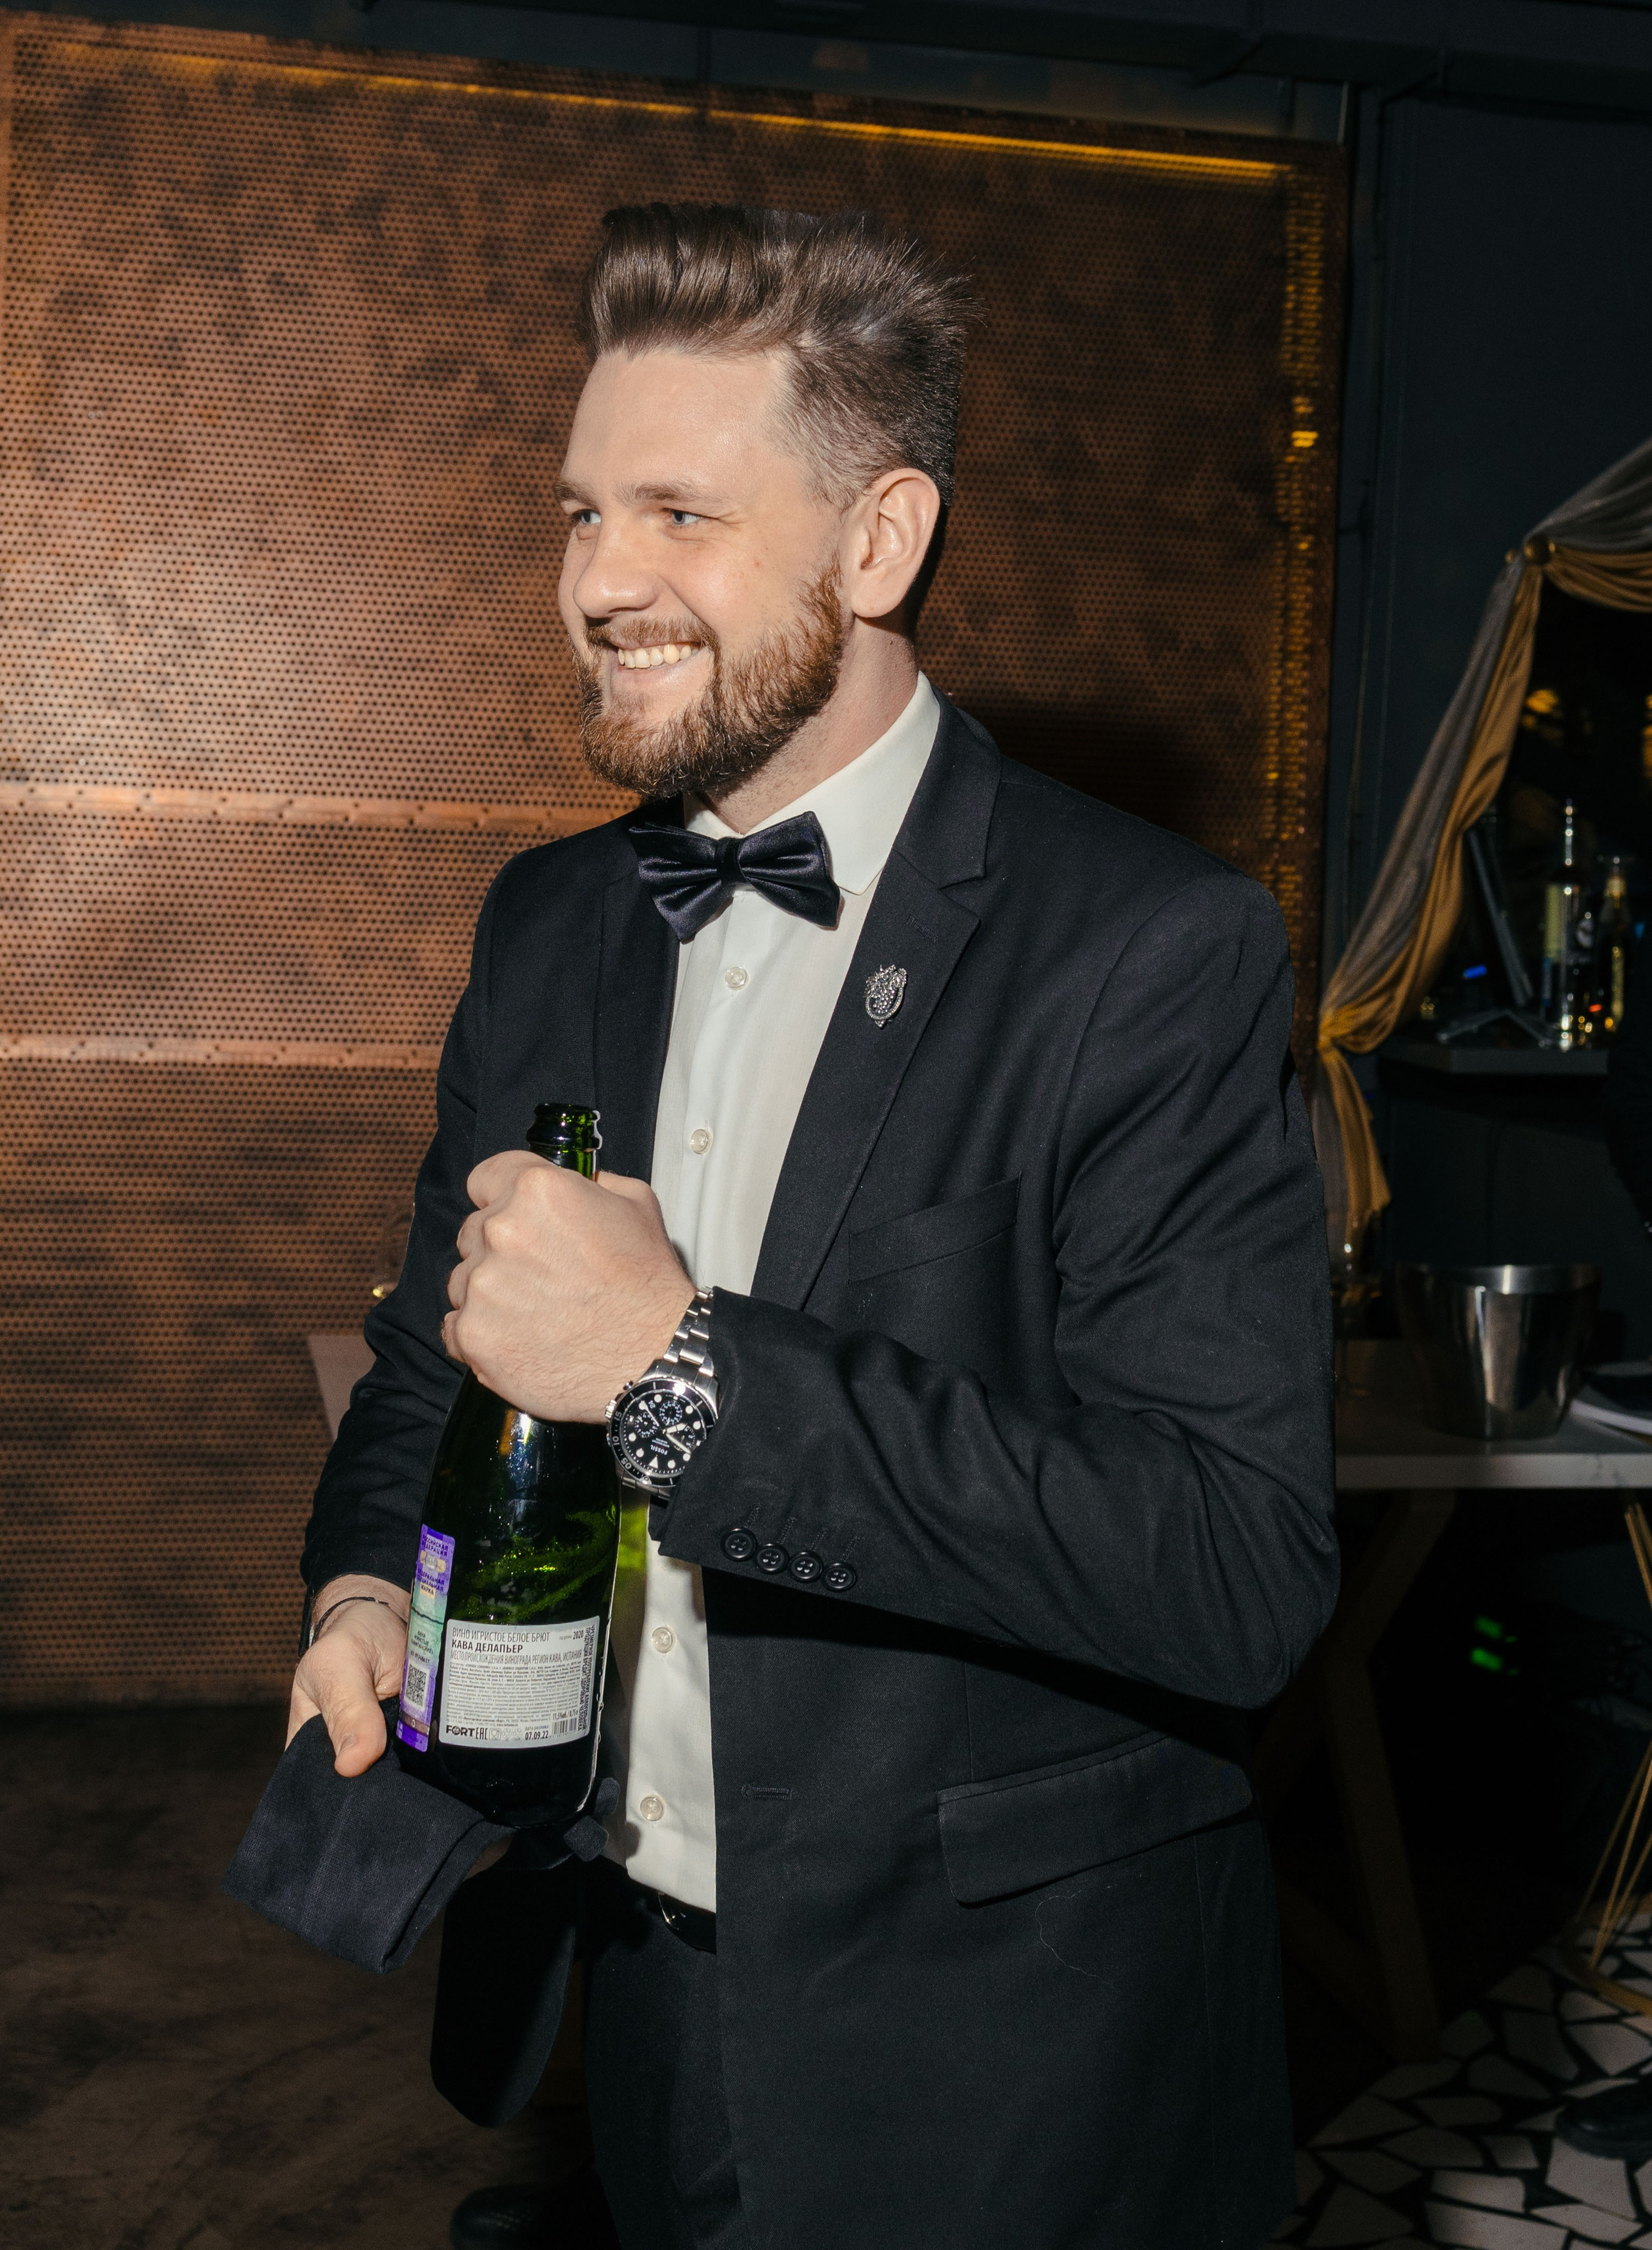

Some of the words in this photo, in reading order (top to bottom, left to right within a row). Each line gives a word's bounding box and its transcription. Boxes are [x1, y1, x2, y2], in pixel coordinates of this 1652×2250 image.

[614, 1411, 622, 1421] 15
[612, 1436, 620, 1445] 10
[650, 1445, 668, 1455] FOSSIL
[621, 1458, 632, 1469] 05
[422, 1534, 448, 1551] РОССИЙСКАЯ
[421, 1584, 434, 1595] МАРКА
[452, 1627, 470, 1639] ВИНО
[472, 1630, 506, 1642] ИГРИСТОЕ
[507, 1632, 530, 1642] БЕЛОЕ
[531, 1632, 550, 1642] БРЮТ
[573, 1629, 583, 1640] 2020
[452, 1639, 473, 1650] КАВА
[475, 1642, 523, 1653] ДЕЛАПЬЕР
[451, 1649, 464, 1661] МЕСТО
[465, 1651, 503, 1665] ПРОИСХОЖДЕНИЯ
[505, 1654, 531, 1665] ВИНОГРАДА
[532, 1654, 549, 1665] РЕГИОН
[549, 1652, 562, 1663] КАВА,
[446, 1725, 475, 1737] FORT
[525, 1731, 549, 1741] 07.09.22
